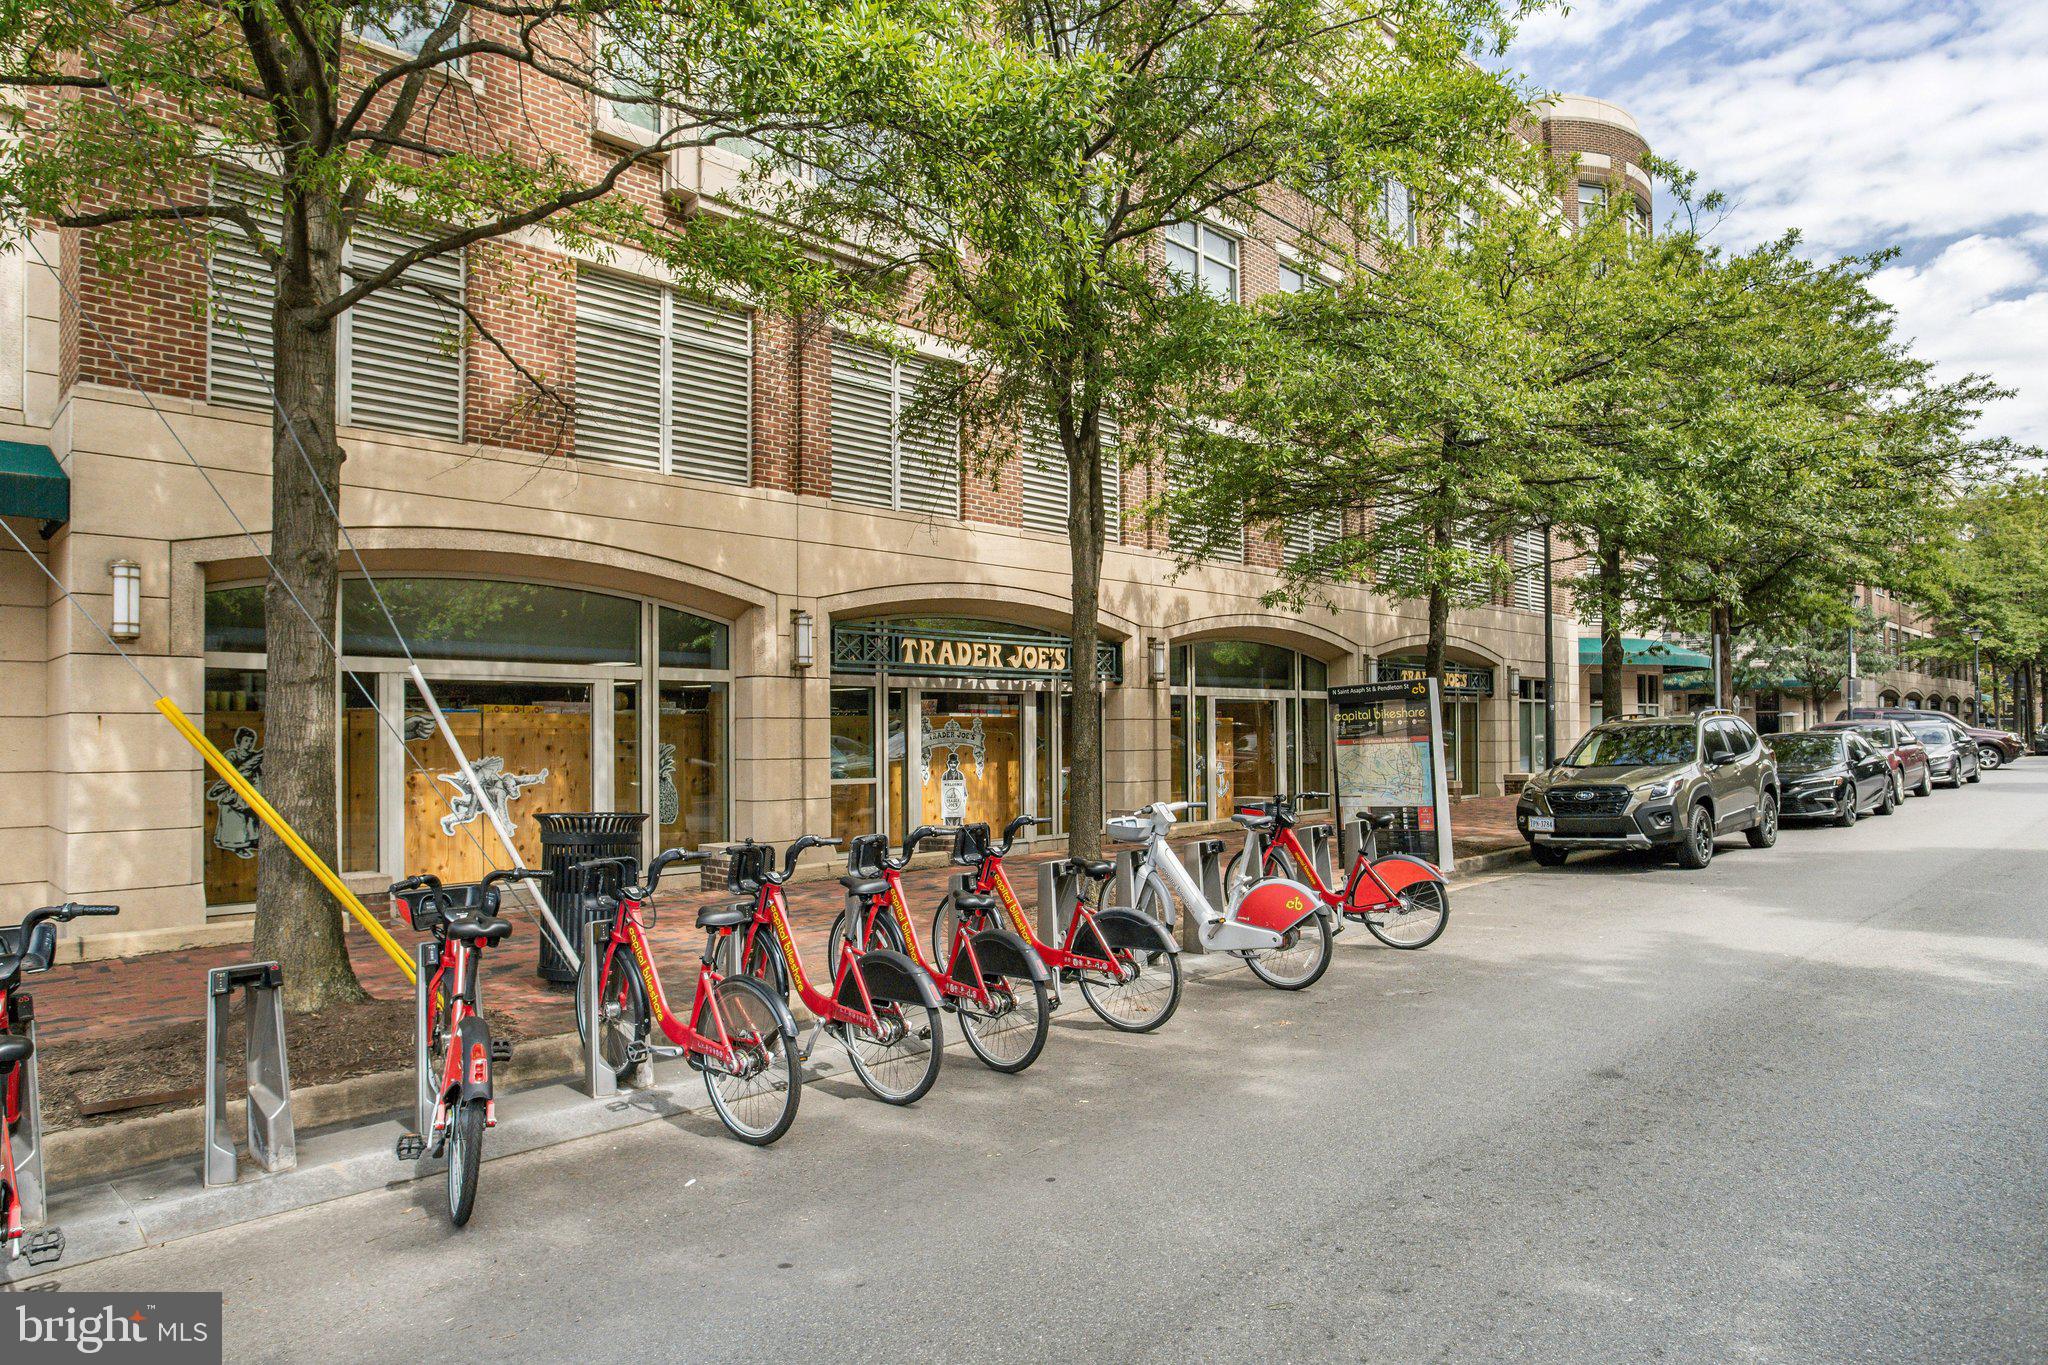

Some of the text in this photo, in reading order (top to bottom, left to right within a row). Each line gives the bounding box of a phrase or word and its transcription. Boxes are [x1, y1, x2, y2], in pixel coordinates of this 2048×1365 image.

[901, 637, 1066, 671] TRADER JOE'S
[1337, 687, 1349, 695] Saint
[1350, 687, 1365, 695] Asaph
[1377, 684, 1402, 692] Pendleton
[1401, 670, 1427, 681] TRA
[1334, 708, 1371, 723] capital
[1373, 706, 1426, 720] bikeshare
[929, 731, 976, 741] TRADER JOE'S
[994, 873, 1032, 945] capital bikeshare
[890, 888, 920, 966] capital bikeshar
[770, 905, 804, 993] capital bikeshare
[628, 927, 664, 1023] capital bikeshare
